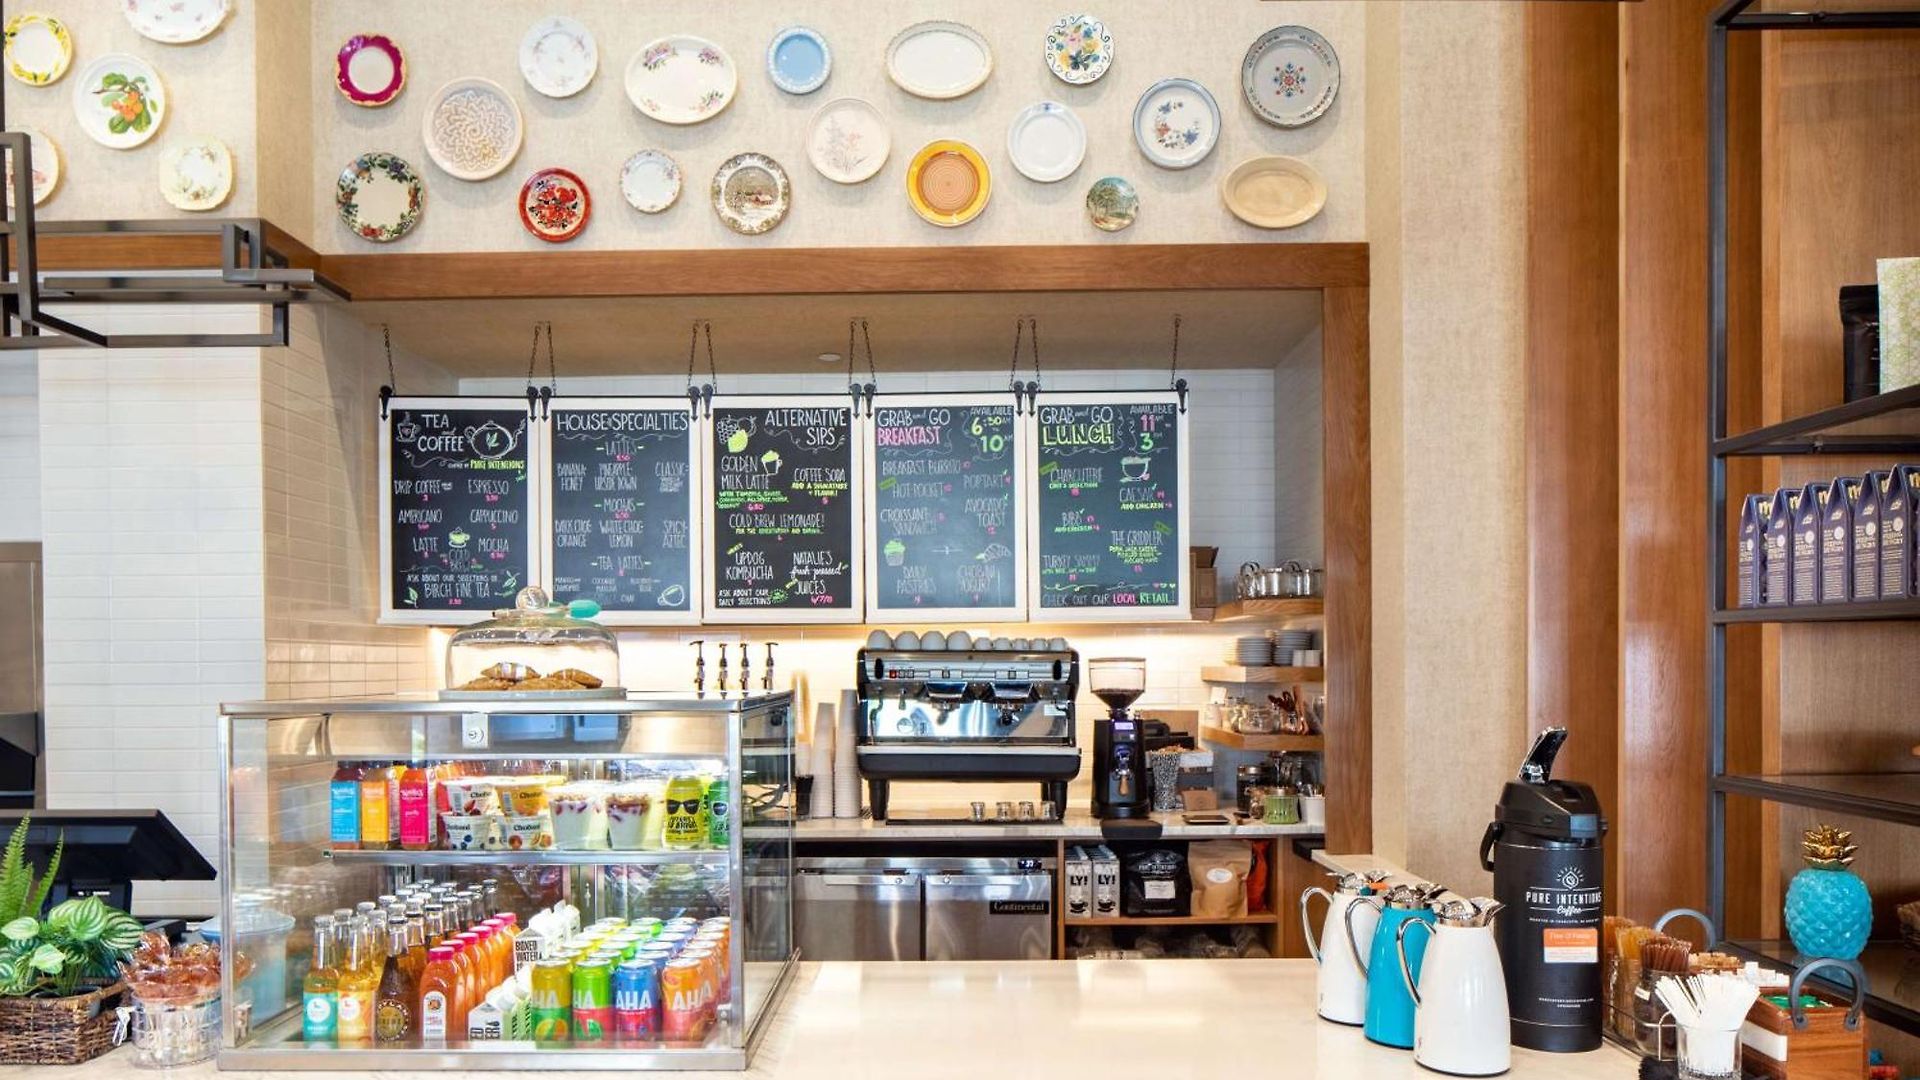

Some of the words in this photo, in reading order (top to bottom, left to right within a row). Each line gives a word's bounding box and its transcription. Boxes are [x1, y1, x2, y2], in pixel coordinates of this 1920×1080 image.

[970, 407, 1012, 416] AVAILABLE
[1040, 407, 1075, 424] GRAB
[1091, 406, 1113, 423] GO
[1130, 405, 1173, 414] AVAILABLE
[421, 414, 449, 429] TEA
[557, 413, 608, 431] HOUSE
[612, 412, 688, 431] SPECIALTIES
[765, 409, 847, 426] ALTERNATIVE
[878, 410, 913, 427] GRAB
[929, 408, 950, 425] GO
[1140, 414, 1155, 431] 11
[806, 427, 835, 445] SIPS
[878, 426, 941, 446] BREAKFAST
[1043, 423, 1114, 445] LUNCH
[1140, 433, 1153, 450] 3
[417, 436, 465, 452] COFFEE
[605, 440, 637, 456] LATTES
[980, 435, 1004, 452] 10
[470, 460, 487, 470] PURE
[488, 460, 525, 470] INTENTIONS
[722, 456, 758, 472] GOLDEN
[882, 460, 925, 475] BREAKFAST
[929, 460, 961, 474] BURRITO
[721, 475, 742, 490] MILK
[746, 474, 769, 490] LATTE
[794, 468, 822, 482] COFFEE
[825, 468, 846, 482] SODA
[394, 480, 412, 494] DRIP
[415, 480, 441, 494] COFFEE
[468, 480, 509, 495] ESPRESSO
[561, 477, 583, 491] HONEY
[1119, 487, 1154, 502] CAESAR
[398, 509, 442, 523] AMERICANO
[470, 509, 518, 523] CAPPUCCINO
[729, 514, 751, 528] COLD
[755, 514, 776, 527] BREW
[977, 512, 1005, 527] TOAST
[599, 521, 621, 534] WHITE
[413, 537, 438, 552] LATTE
[478, 538, 509, 552] MOCHA
[557, 535, 586, 547] ORANGE
[609, 535, 633, 548] LEMON
[662, 535, 686, 548] AZTEC
[1111, 530, 1125, 545] THE
[1127, 530, 1163, 545] GRIDDLER
[597, 556, 613, 570] TEA
[735, 552, 765, 565] UPDOG
[1042, 555, 1071, 568] TURKEY
[422, 574, 440, 582] ABOUT
[727, 565, 773, 580] KOMBUCHA
[424, 583, 452, 598] BIRCH
[456, 583, 472, 598] FINE
[477, 582, 490, 597] TEA
[733, 589, 752, 597] ABOUT
[795, 579, 826, 595] JUICES
[897, 578, 936, 594] PASTRIES
[1042, 595, 1069, 606] CHECK
[1073, 595, 1088, 605] OUT
[1093, 594, 1109, 605] OUR
[1113, 593, 1136, 604] LOCAL
[1070, 875, 1088, 886] LY!
[1098, 874, 1116, 885] LY!
[1526, 891, 1551, 904] PURE
[1557, 892, 1601, 904] INTENTIONS
[994, 901, 1044, 912] Continental
[1557, 906, 1582, 916] Coffee
[515, 940, 537, 951] BOXED
[516, 951, 537, 961] WATER
[531, 990, 560, 1008] HA
[573, 990, 596, 1009] HA
[616, 990, 652, 1010] AHA
